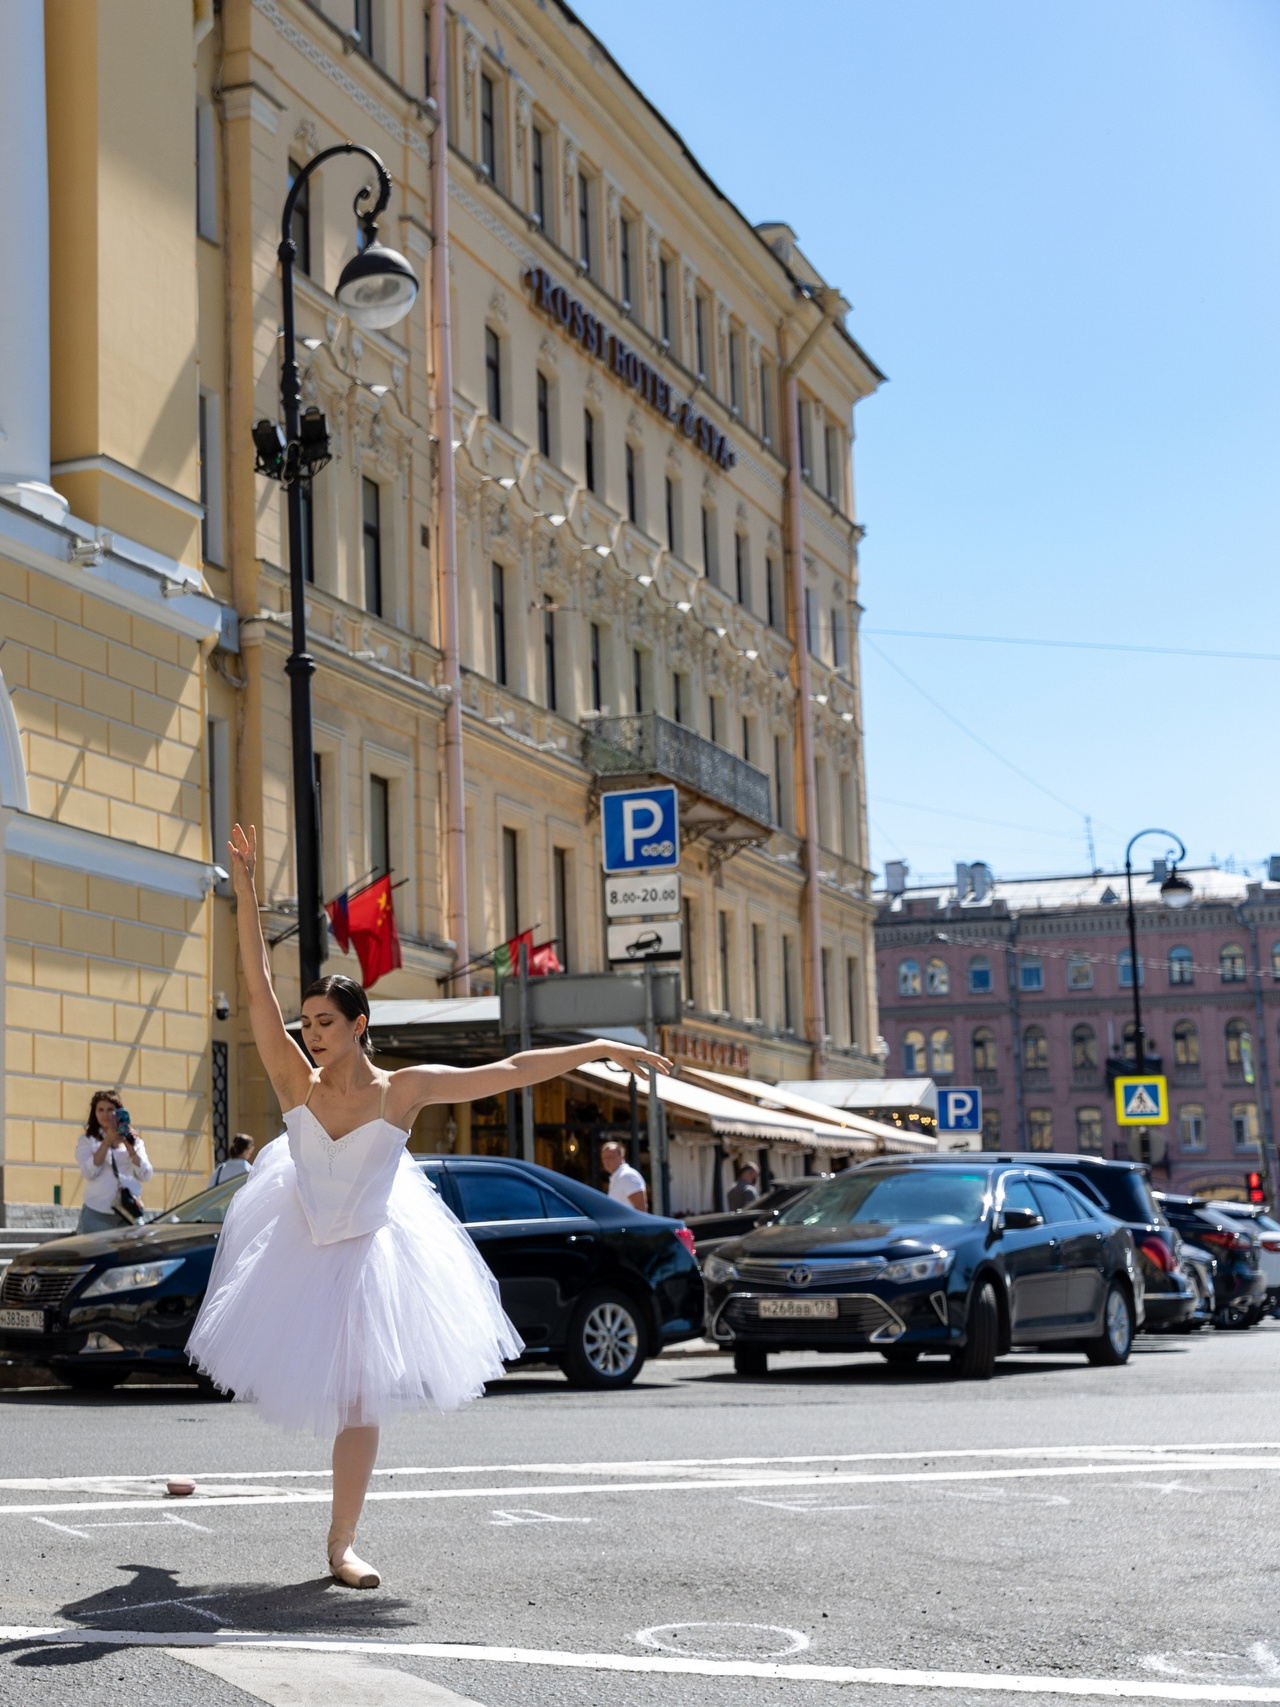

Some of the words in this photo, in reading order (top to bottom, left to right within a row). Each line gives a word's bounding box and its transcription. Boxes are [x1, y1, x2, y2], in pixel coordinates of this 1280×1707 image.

[536, 268, 607, 360] ROSSI
[610, 336, 677, 423] HOTEL
[695, 416, 729, 472] SPA
[622, 798, 664, 862] P
[610, 888, 676, 905] 8.00-20.00
[947, 1091, 973, 1128] P
